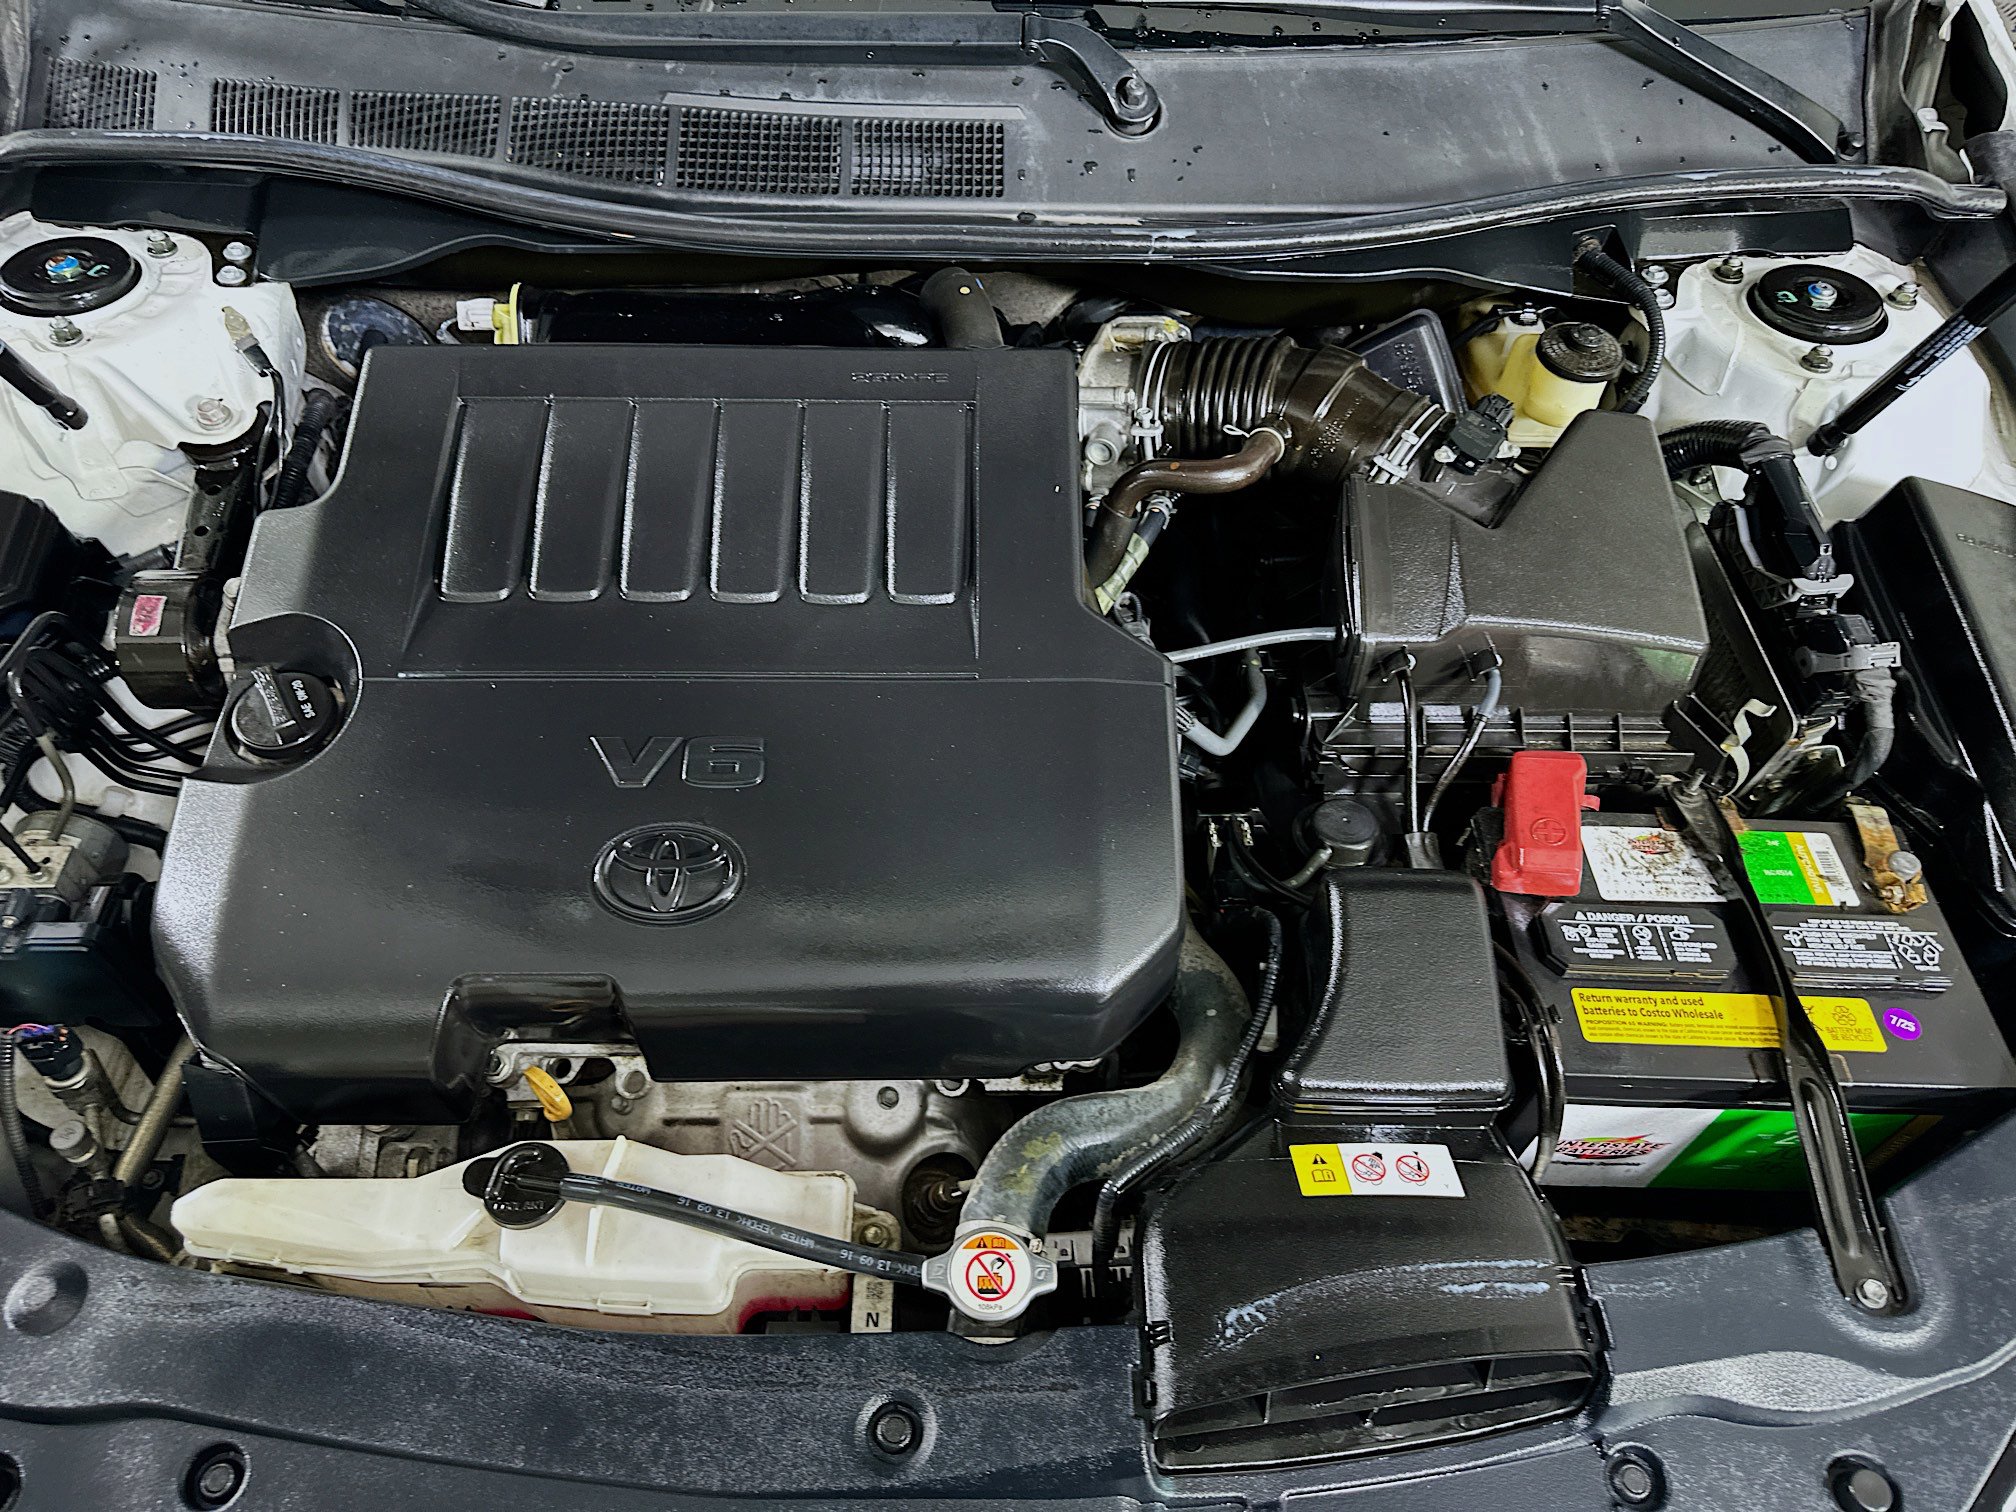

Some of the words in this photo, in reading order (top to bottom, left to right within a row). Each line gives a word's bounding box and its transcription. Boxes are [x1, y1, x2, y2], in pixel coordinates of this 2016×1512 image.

[300, 702, 316, 719] SAE
[589, 736, 764, 788] V6
[1586, 911, 1637, 923] DANGER
[1645, 914, 1691, 924] POISON
[1578, 992, 1613, 1004] Return
[1614, 994, 1658, 1007] warranty
[1660, 995, 1680, 1006] and
[1681, 996, 1704, 1006] used
[1582, 1005, 1626, 1017] batteries
[1627, 1007, 1638, 1017] to
[1639, 1007, 1671, 1018] Costco
[1672, 1008, 1724, 1020] Wholesale
[1889, 1014, 1916, 1032] 7/25
[677, 1195, 691, 1208] 16
[697, 1202, 713, 1214] 09
[715, 1208, 730, 1221] 13
[780, 1229, 815, 1249] WATER
[839, 1248, 853, 1261] 16
[859, 1254, 874, 1267] 09
[876, 1259, 892, 1272] 13
[866, 1312, 880, 1328] N
